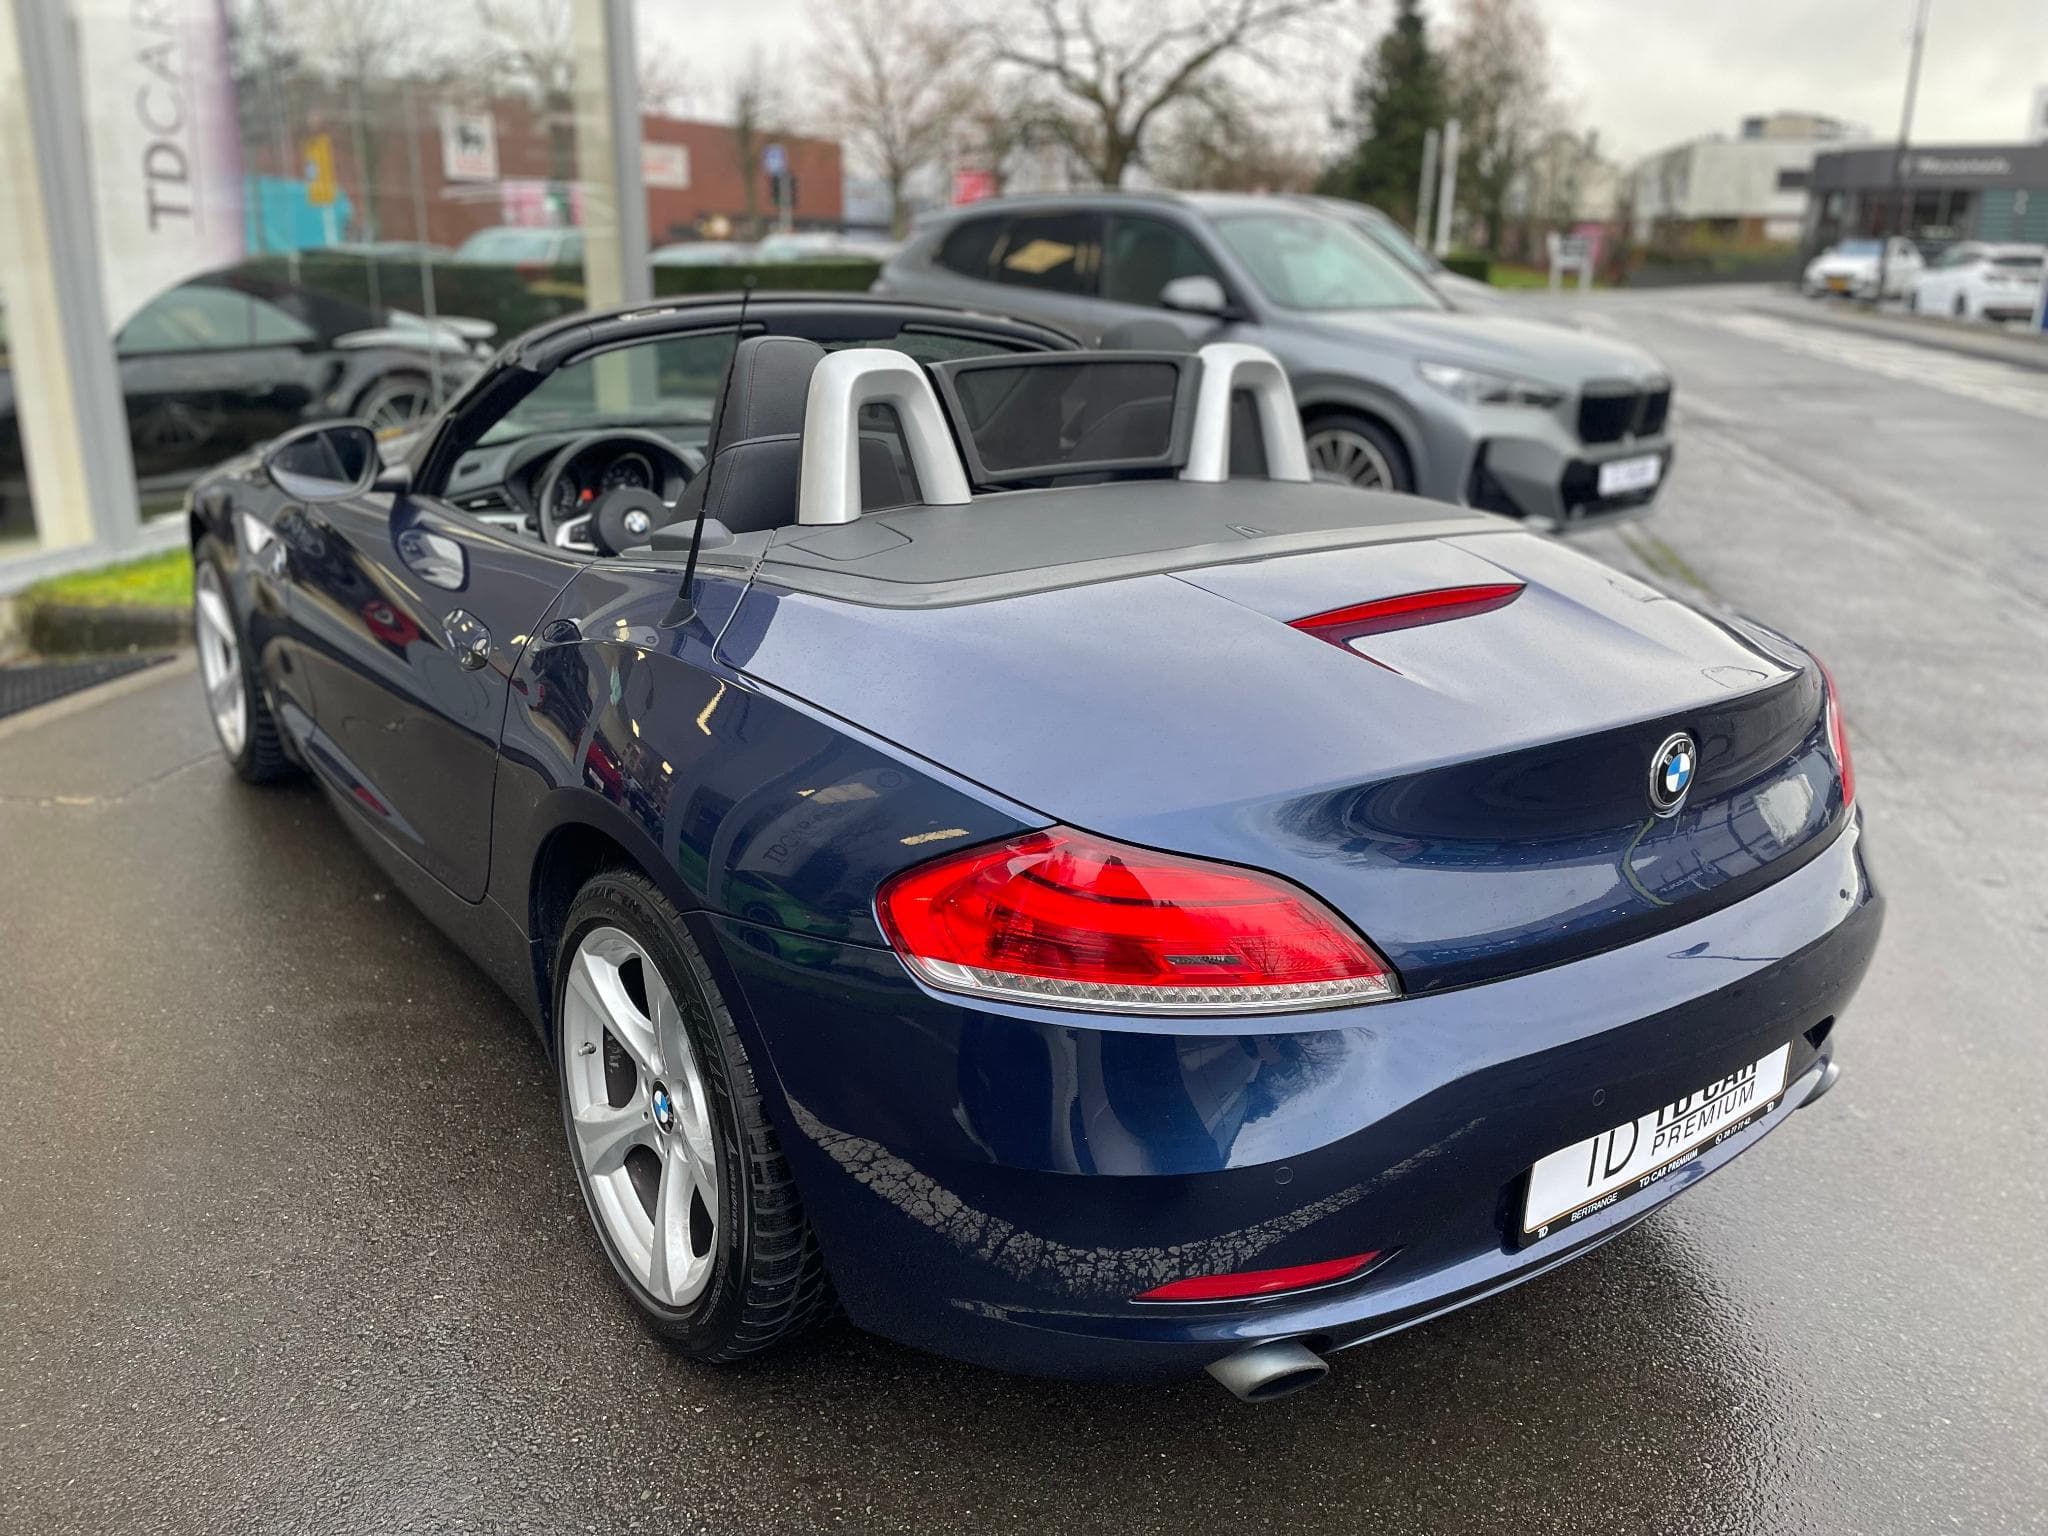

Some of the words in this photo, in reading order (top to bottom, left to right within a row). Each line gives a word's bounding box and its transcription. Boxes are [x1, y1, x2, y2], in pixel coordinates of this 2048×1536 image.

[1651, 1081, 1755, 1156] PREMIUM
[1639, 1176, 1650, 1188] TD
[1651, 1167, 1666, 1181] CAR
[1667, 1148, 1698, 1173] PREMIUM
[1571, 1192, 1618, 1222] BERTRANGE
[1537, 1226, 1549, 1239] TD
